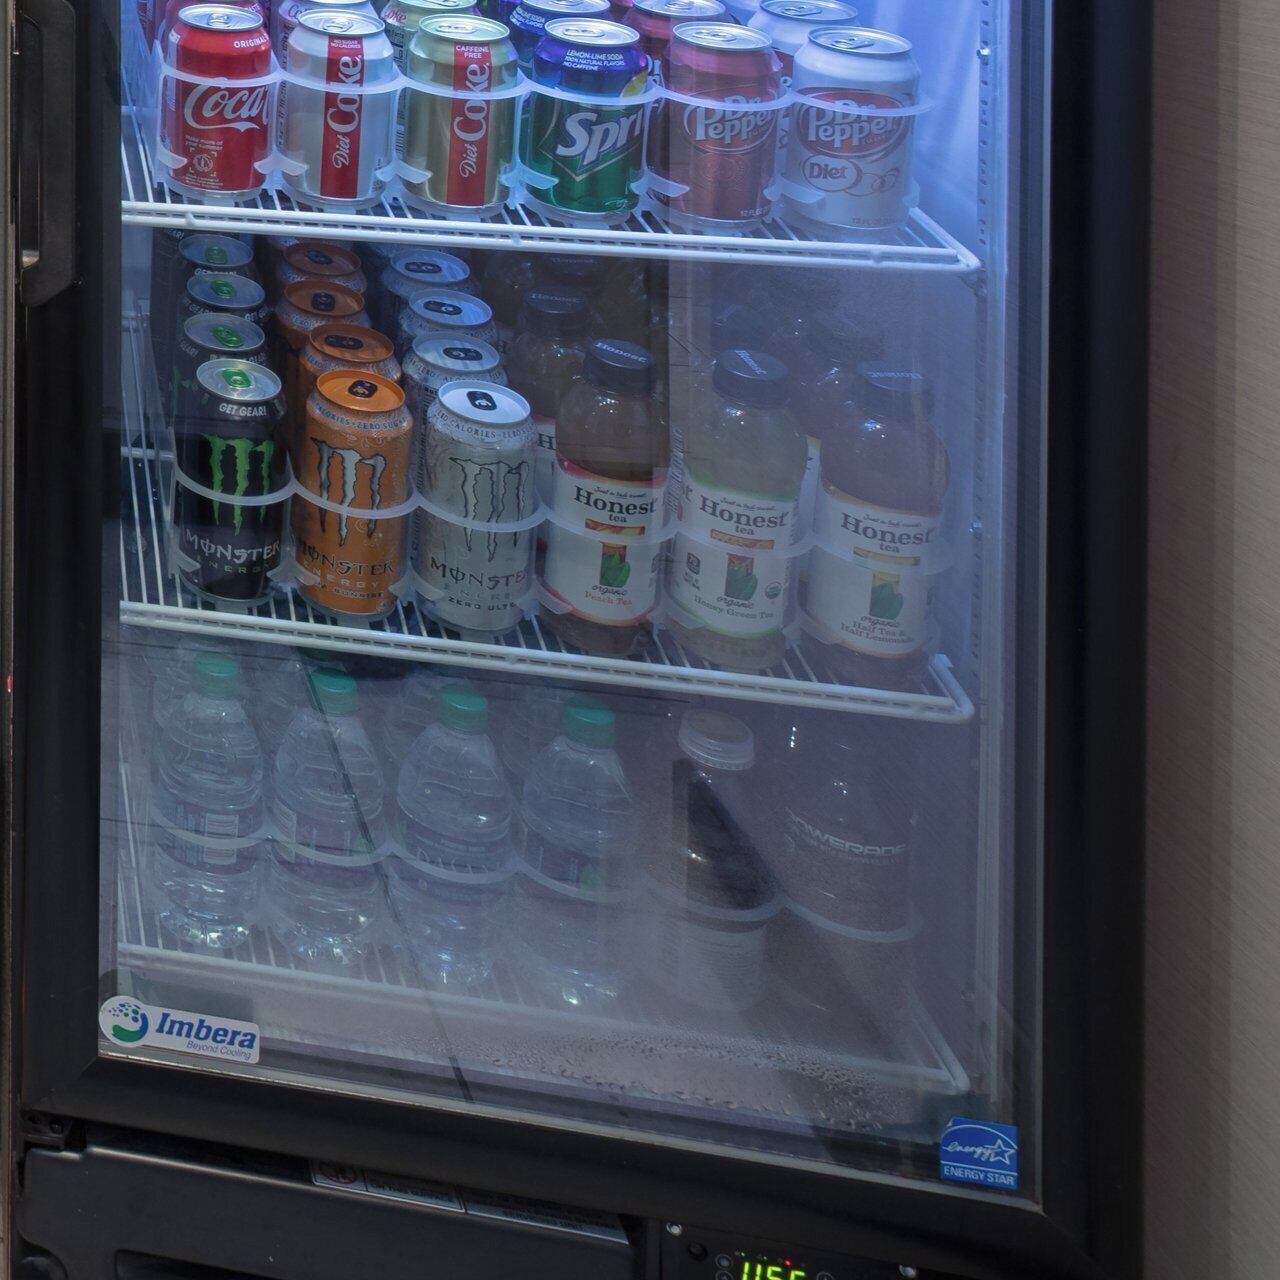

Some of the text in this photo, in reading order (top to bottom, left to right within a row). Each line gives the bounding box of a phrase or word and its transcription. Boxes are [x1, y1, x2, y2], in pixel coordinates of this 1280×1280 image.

[455, 44, 489, 54] CAFFEINE
[332, 134, 351, 169] Diet
[807, 160, 848, 180] Diet
[218, 402, 267, 417] GET GEAR!
[573, 485, 657, 517] Honest
[608, 513, 627, 524] tea
[699, 495, 790, 530] Honest
[734, 526, 755, 537] tea
[156, 1012, 257, 1049] Imbera
[187, 1040, 252, 1061] Beyond Cooling
[944, 1165, 1015, 1187] ENERGY STAR
